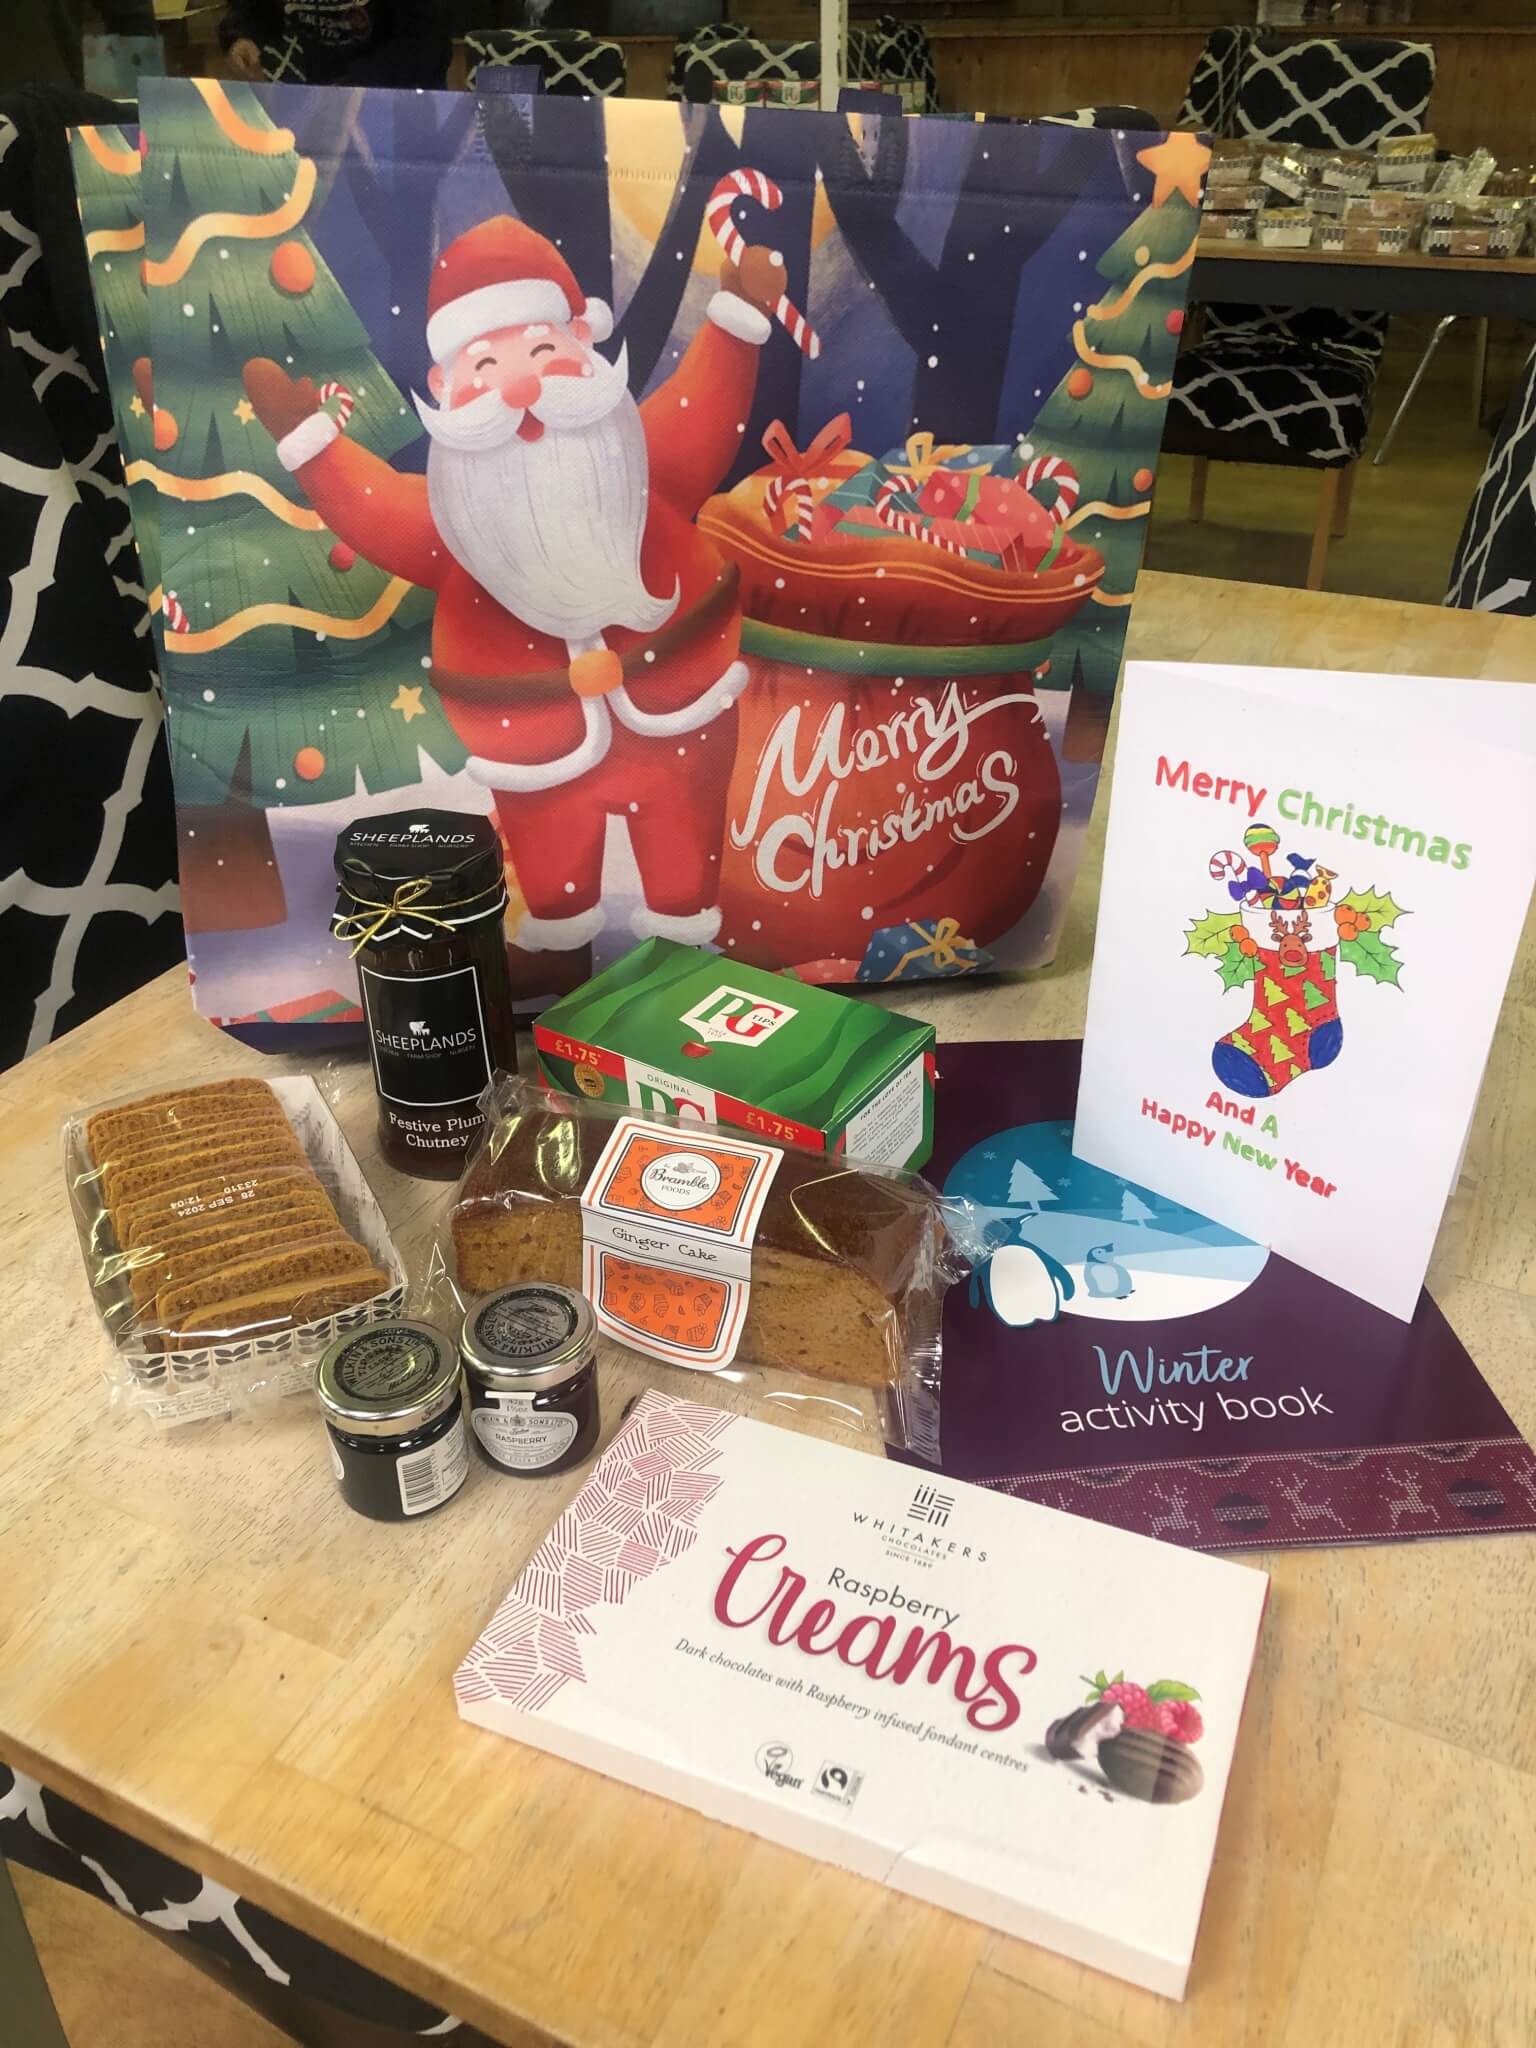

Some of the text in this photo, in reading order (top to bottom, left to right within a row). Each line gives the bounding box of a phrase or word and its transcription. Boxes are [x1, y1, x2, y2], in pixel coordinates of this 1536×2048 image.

[731, 681, 1043, 848] Merry
[753, 750, 1019, 898] Christmas
[1155, 756, 1472, 870] Merry Christmas
[350, 832, 476, 844] SHEEPLANDS
[693, 992, 784, 1037] PG
[752, 1014, 776, 1026] TIPS
[375, 1028, 477, 1051] SHEEPLANDS
[646, 1074, 692, 1096] ORIGINAL
[389, 1111, 486, 1132] Festive Plum
[1206, 1091, 1279, 1138] And A
[406, 1134, 470, 1148] Chutney
[1141, 1098, 1337, 1198] Happy New Year
[649, 1168, 710, 1190] Bramble
[661, 1184, 691, 1195] FOODS
[170, 1195, 201, 1209] 12:04
[177, 1203, 206, 1216] 2024
[208, 1196, 234, 1208] SEP
[612, 1227, 718, 1262] Ginger Cake
[343, 1351, 362, 1385] WILKIN
[370, 1336, 405, 1347] SONS
[509, 1338, 554, 1354] WILKIN
[1092, 1345, 1254, 1395] Winter
[1060, 1386, 1334, 1432] activity book
[495, 1433, 547, 1445] RASPBERRY
[853, 1512, 988, 1562] WHITAKERS
[881, 1534, 947, 1560] CHOCOLATES
[885, 1550, 910, 1563] SINCE
[827, 1567, 960, 1629] Raspberry
[714, 1534, 1037, 1732] Creams
[675, 1638, 1029, 1773] Dark chocolates with Raspberry infused fondant centres
[764, 1758, 804, 1790] Vegan
